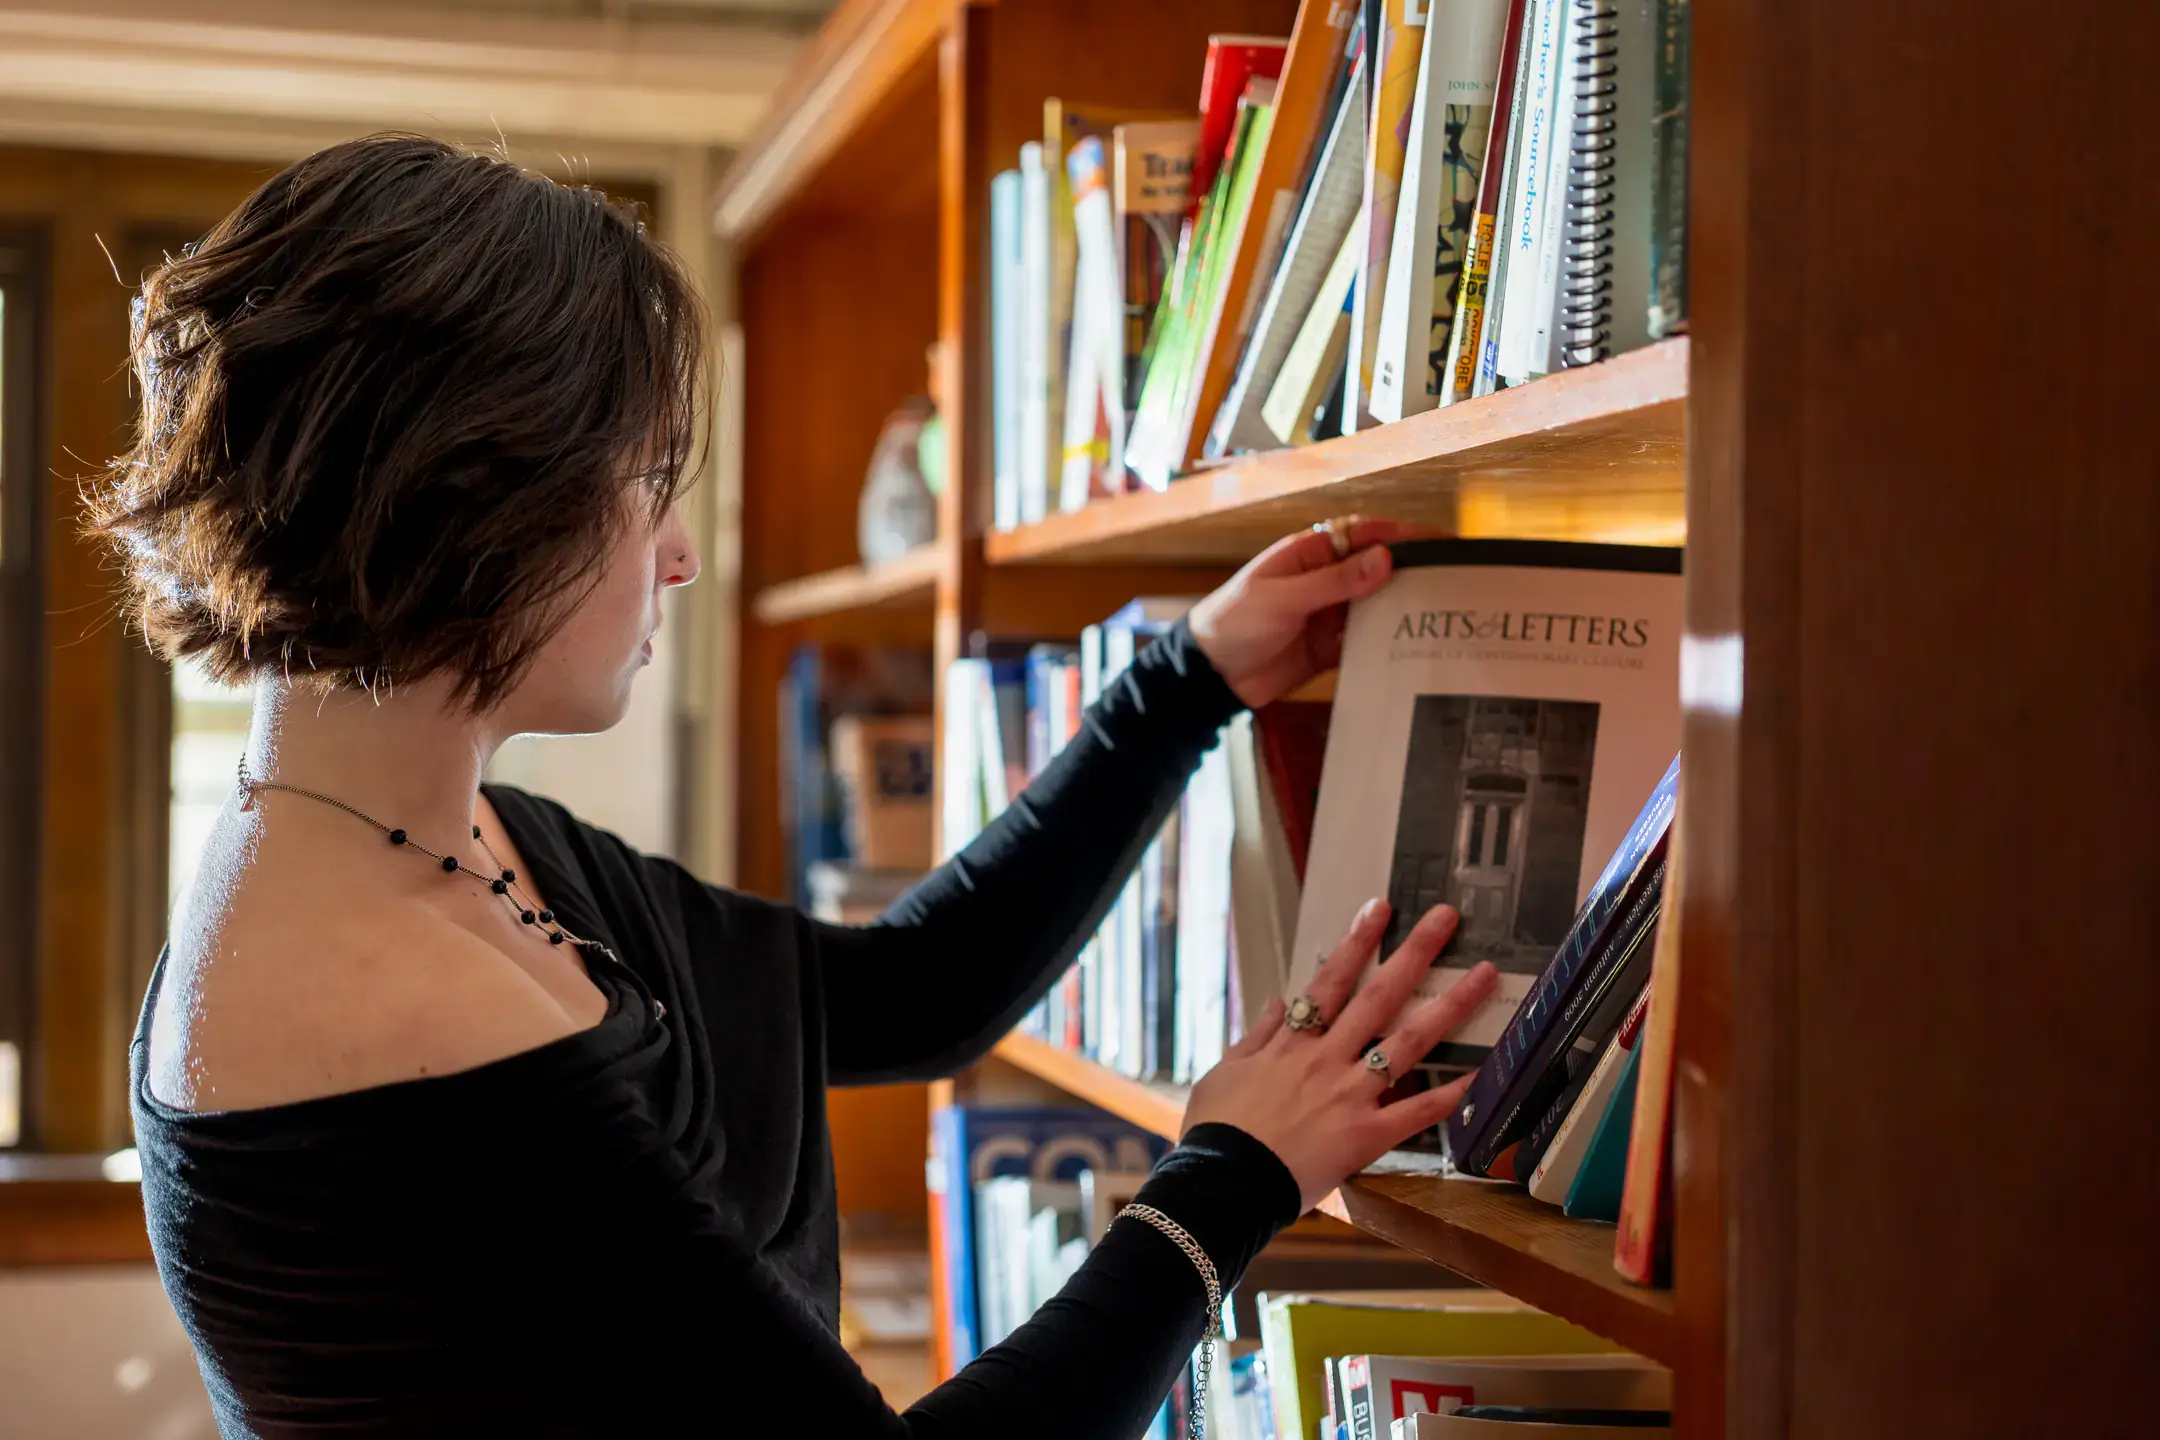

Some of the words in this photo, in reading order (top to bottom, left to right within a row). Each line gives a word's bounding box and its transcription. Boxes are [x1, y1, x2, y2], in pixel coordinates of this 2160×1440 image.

[1520, 105, 1545, 252] Sourcebook
[1393, 609, 1476, 640] ARTS
[1501, 612, 1649, 648] LETTERS
[1624, 883, 1654, 929] Review
[1584, 942, 1616, 992] Autumn
[1564, 991, 1584, 1022] 2009
